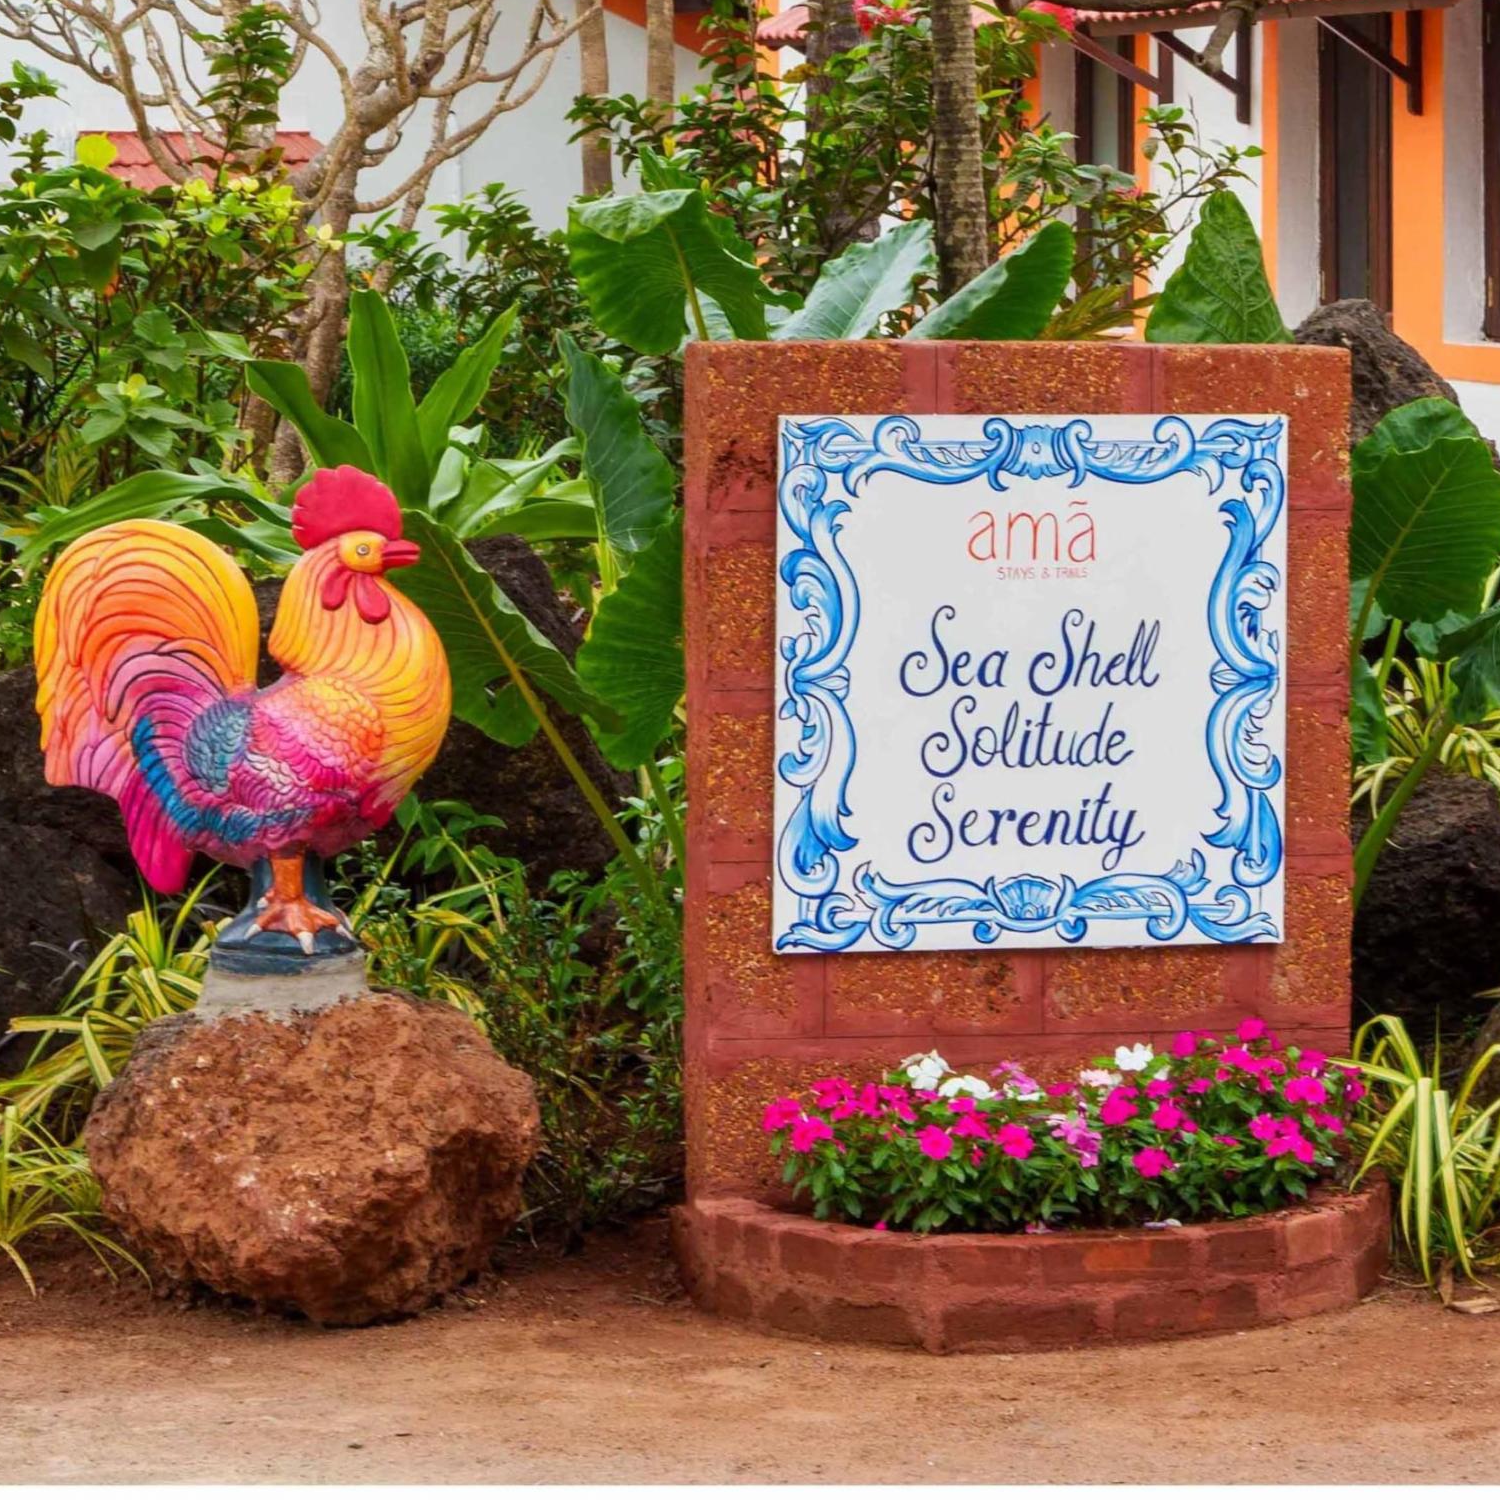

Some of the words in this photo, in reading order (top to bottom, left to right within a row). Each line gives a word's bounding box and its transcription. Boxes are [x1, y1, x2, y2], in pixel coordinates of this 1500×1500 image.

[996, 566, 1035, 581] STAYS
[1040, 566, 1051, 580] &
[899, 605, 1010, 697] Sea
[1028, 609, 1161, 697] Shell
[920, 695, 1135, 779] Solitude
[907, 782, 1146, 872] Serenity
